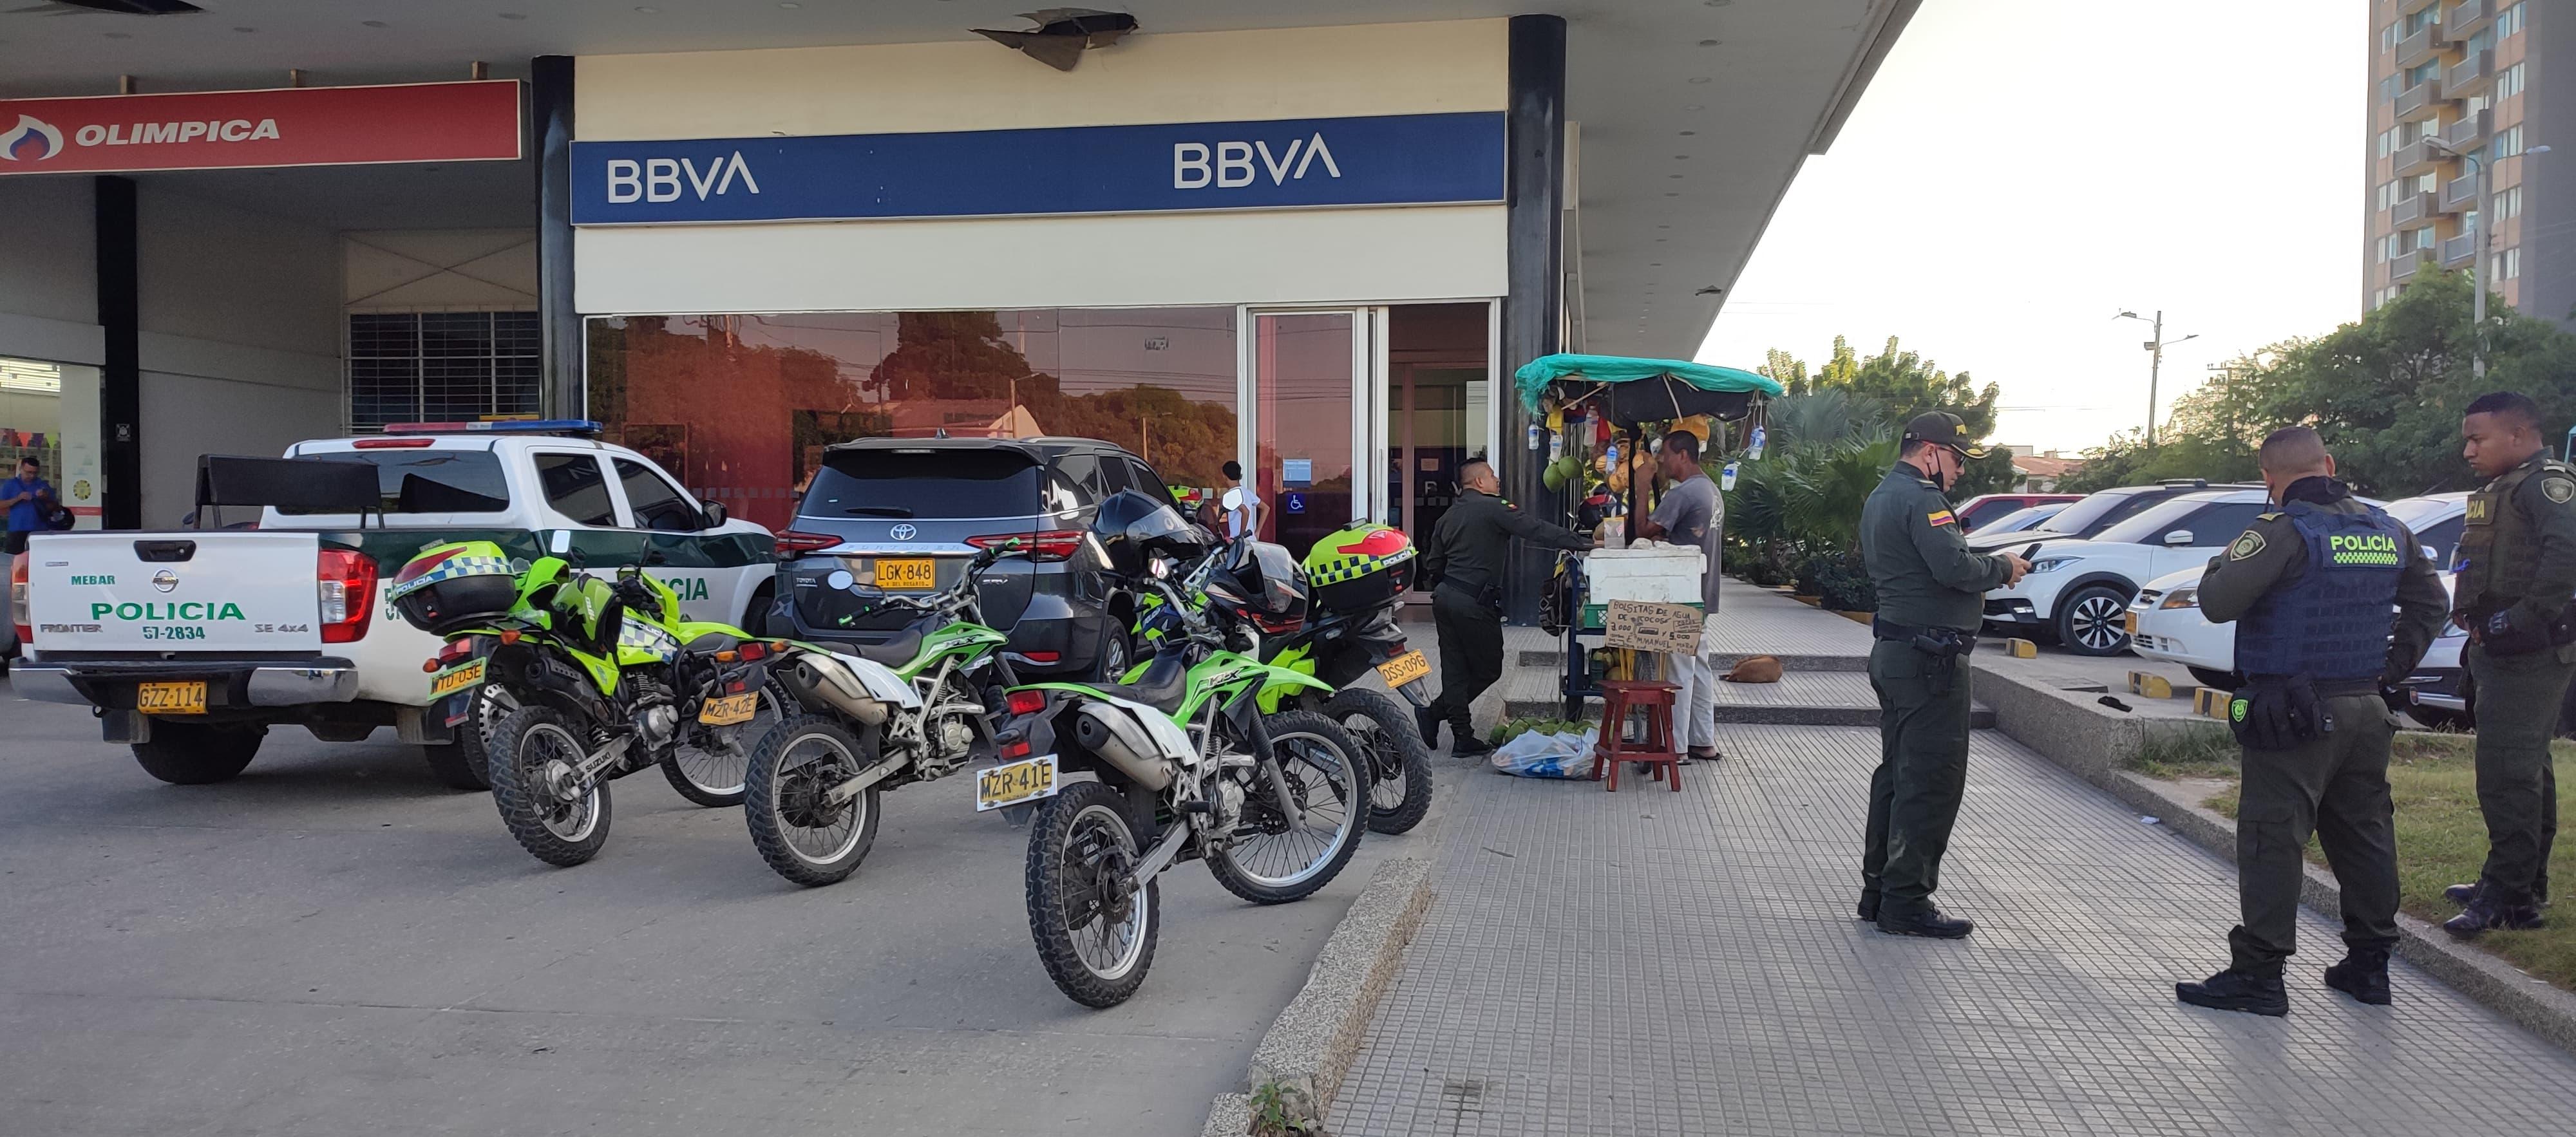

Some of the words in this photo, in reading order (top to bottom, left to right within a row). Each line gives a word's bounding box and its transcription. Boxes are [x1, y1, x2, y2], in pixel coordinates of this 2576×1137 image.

[75, 118, 280, 147] OLIMPICA
[1174, 132, 1341, 189] BBVA
[608, 150, 759, 203] BBVA
[71, 575, 115, 585] MEBAR
[91, 602, 247, 620] POLICIA
[1613, 601, 1654, 615] BOLSITAS
[1656, 608, 1668, 616] DE
[40, 624, 103, 633] FRONTIER
[142, 626, 205, 640] 57-2834
[254, 624, 274, 633] SE
[585, 751, 612, 773] SUZUKI
